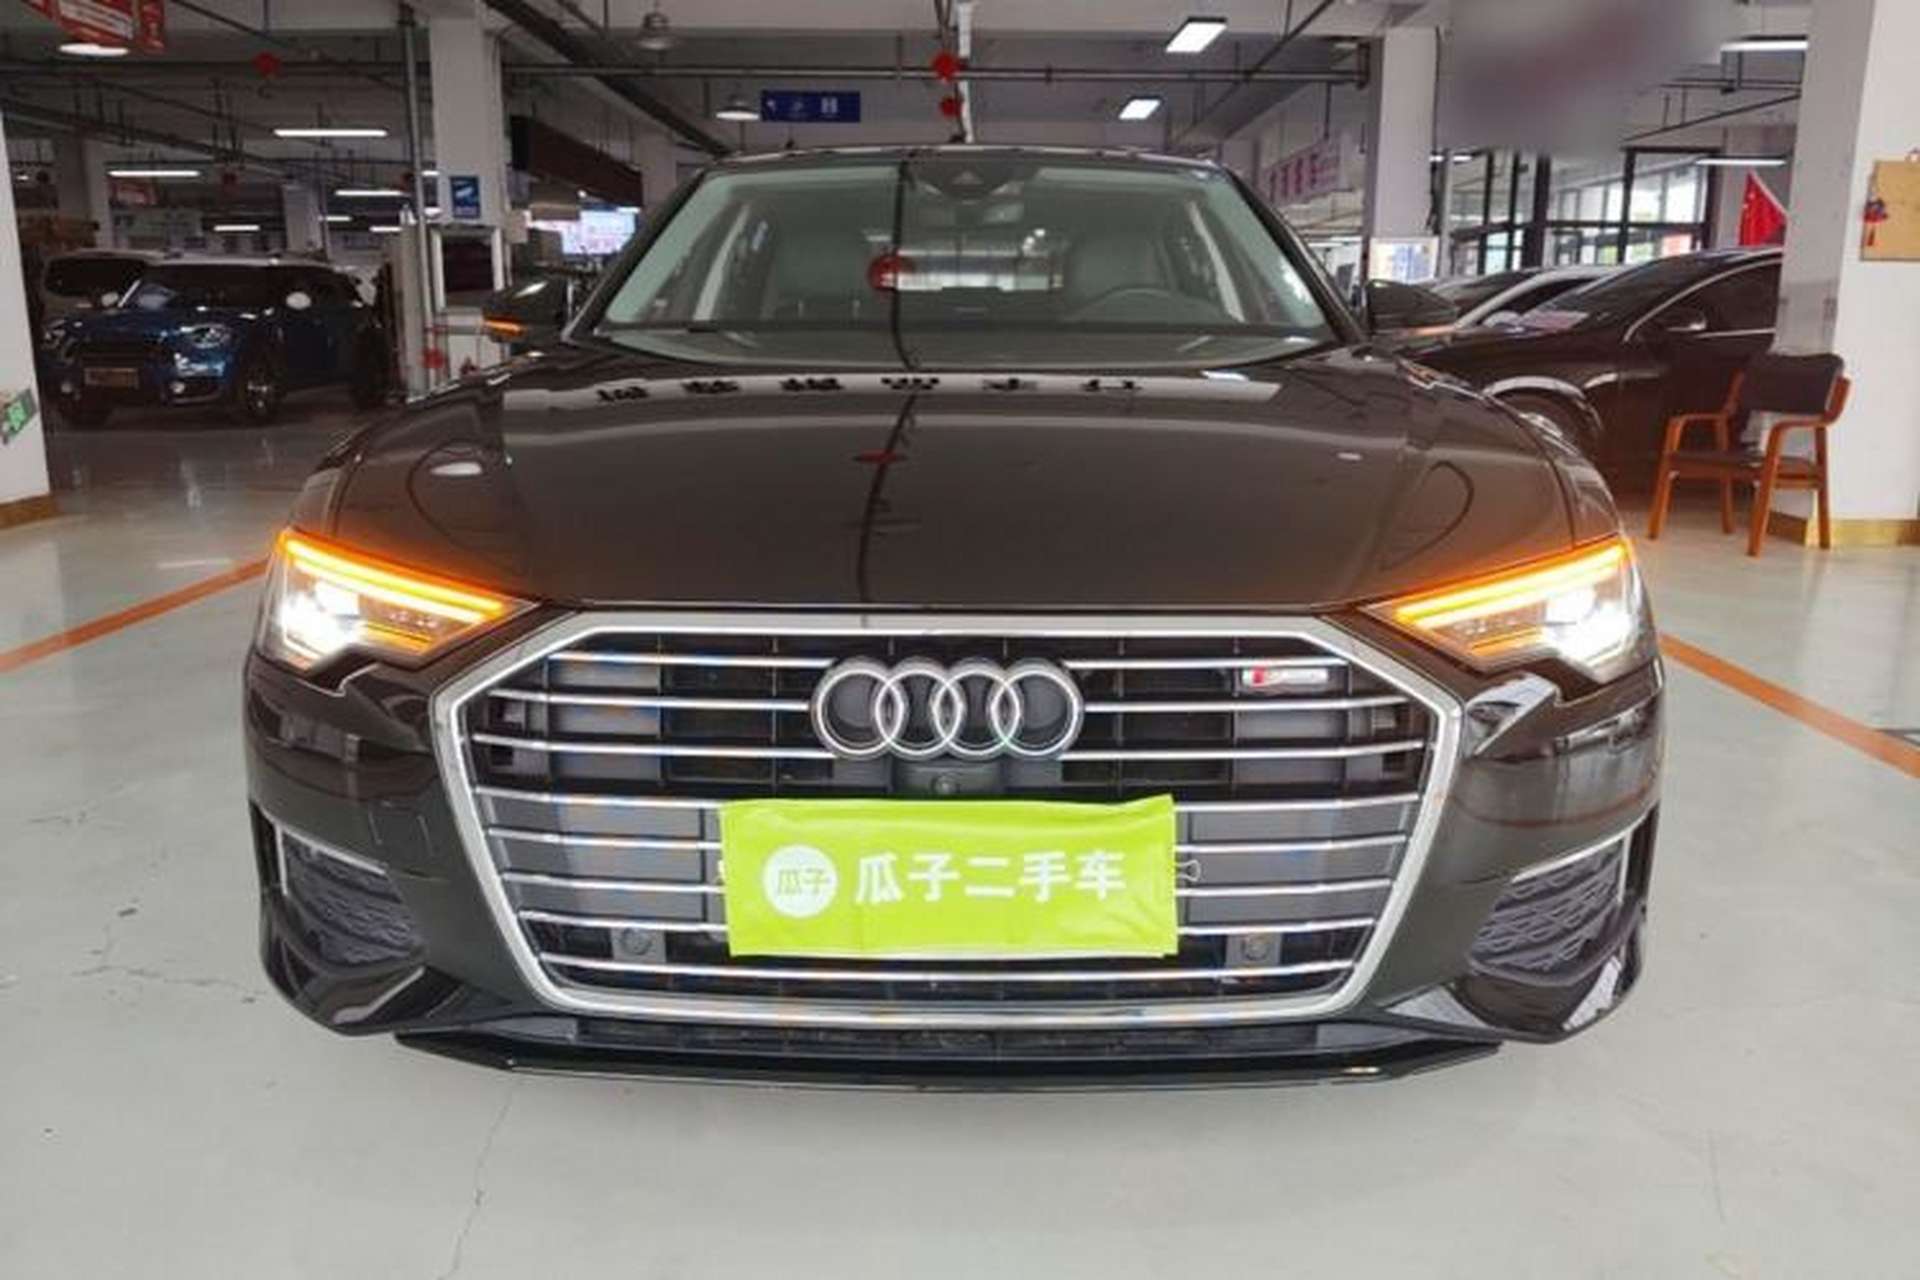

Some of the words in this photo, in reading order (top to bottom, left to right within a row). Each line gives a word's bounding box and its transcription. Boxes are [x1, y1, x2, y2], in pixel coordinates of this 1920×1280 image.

[777, 866, 832, 895] 瓜子
[856, 850, 1126, 903] 瓜子二手车
